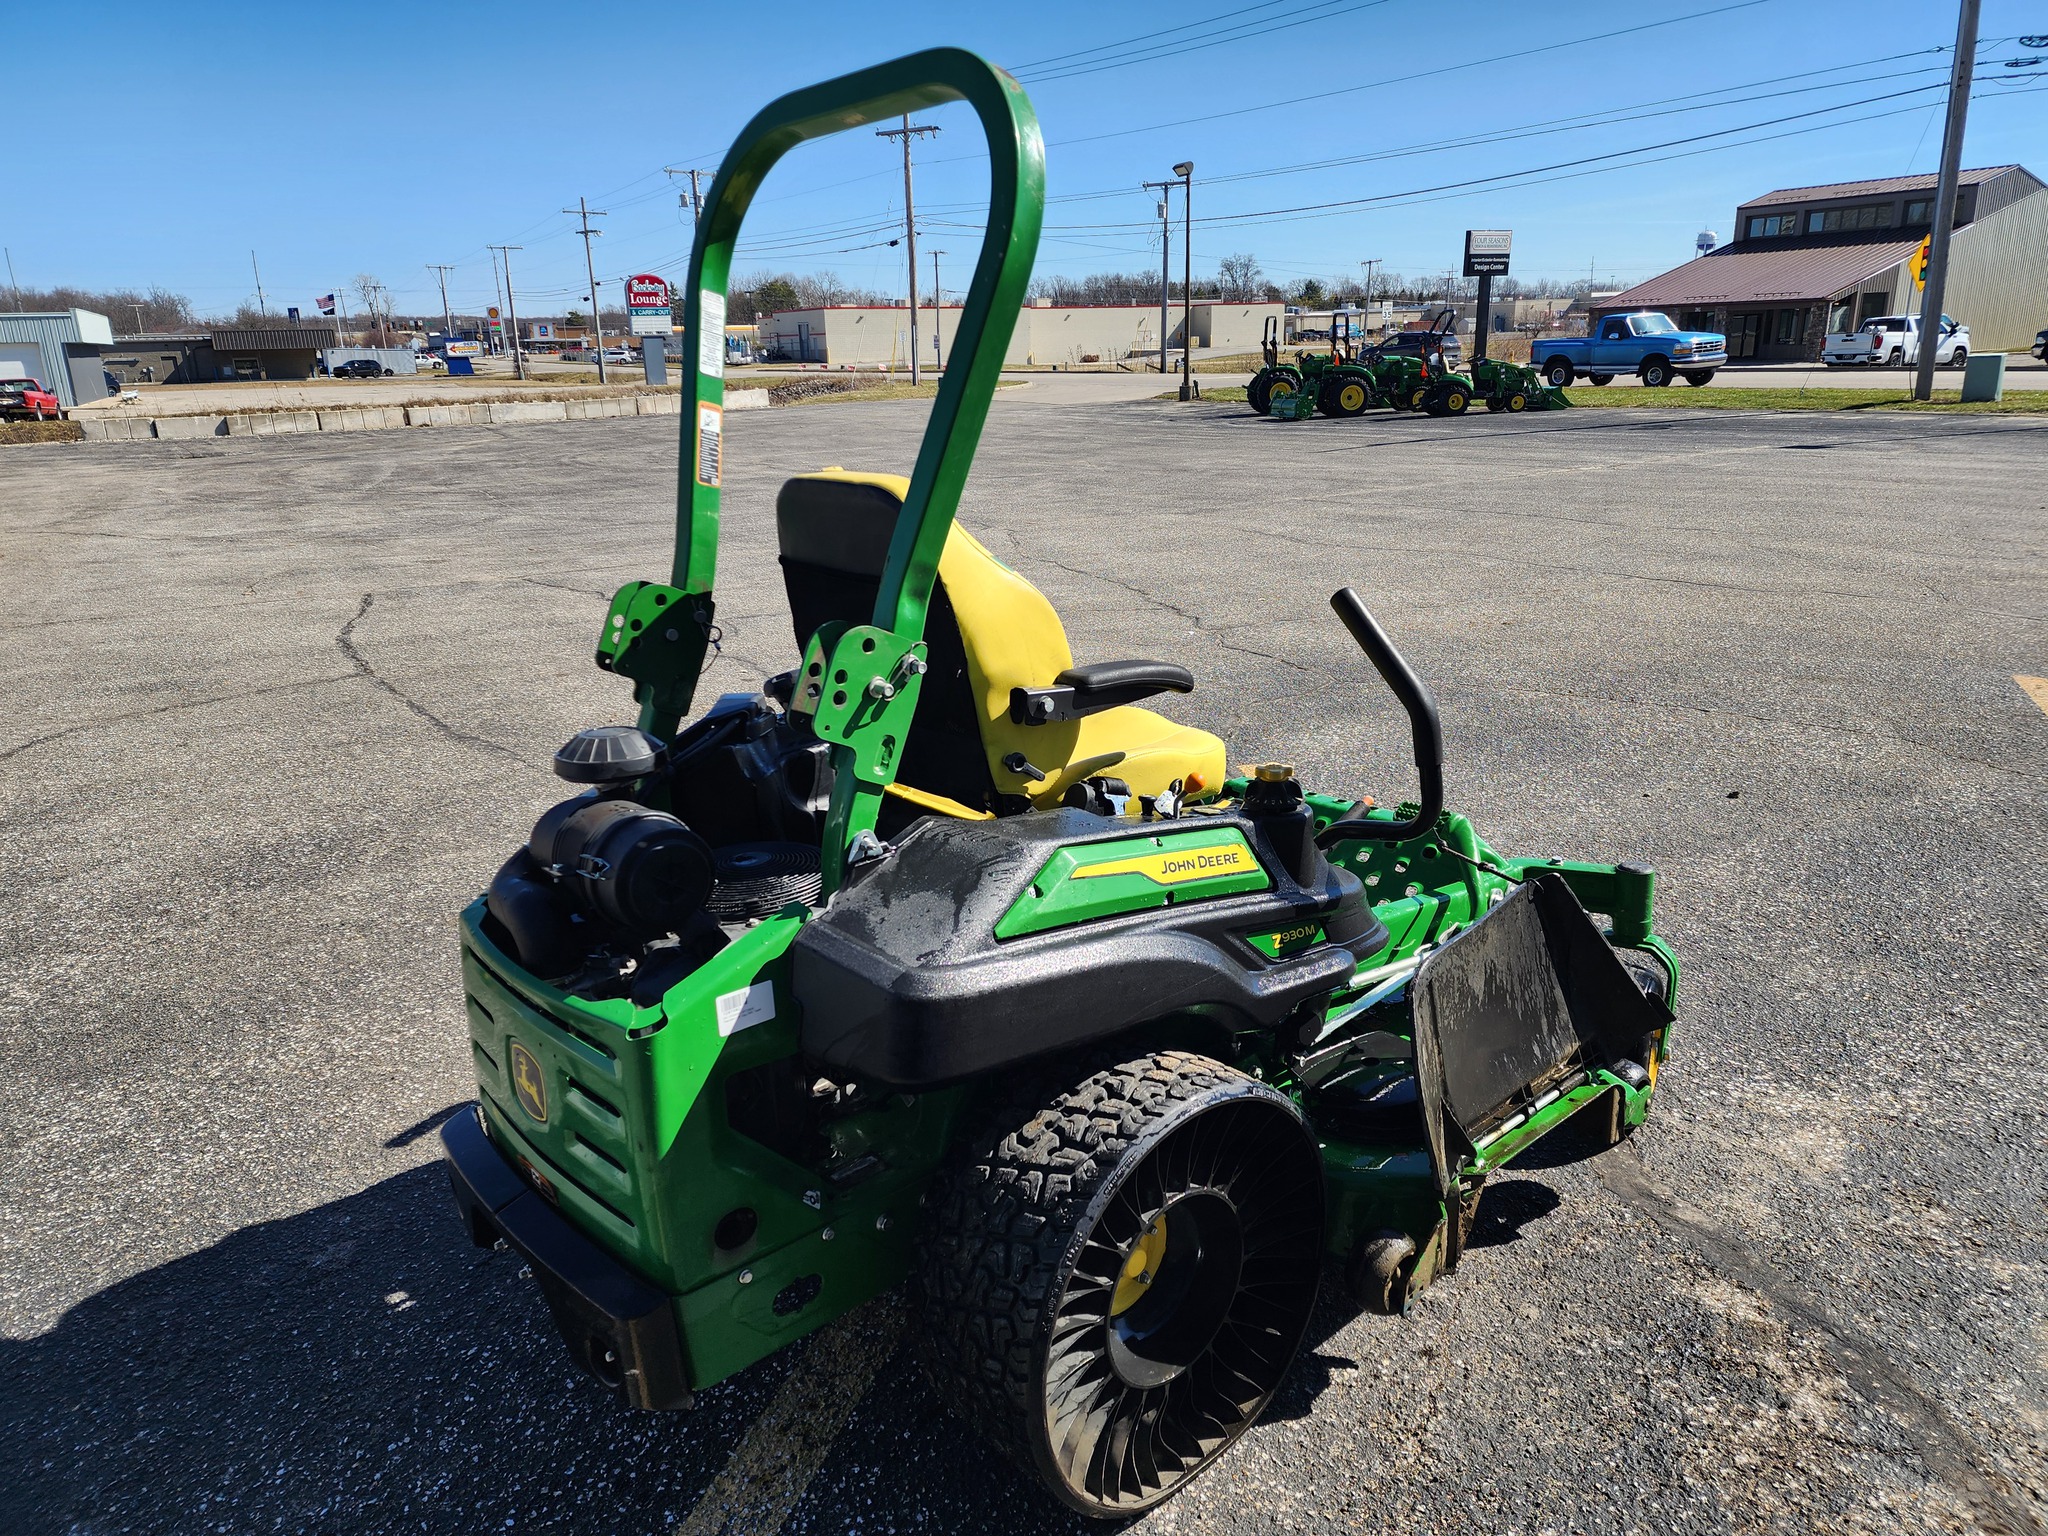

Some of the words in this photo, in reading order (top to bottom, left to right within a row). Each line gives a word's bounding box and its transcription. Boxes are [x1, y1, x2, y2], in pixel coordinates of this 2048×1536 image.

[630, 293, 668, 306] Lounge
[1162, 859, 1196, 875] JOHN
[1197, 852, 1240, 869] DEERE
[1271, 924, 1316, 949] Z930M
